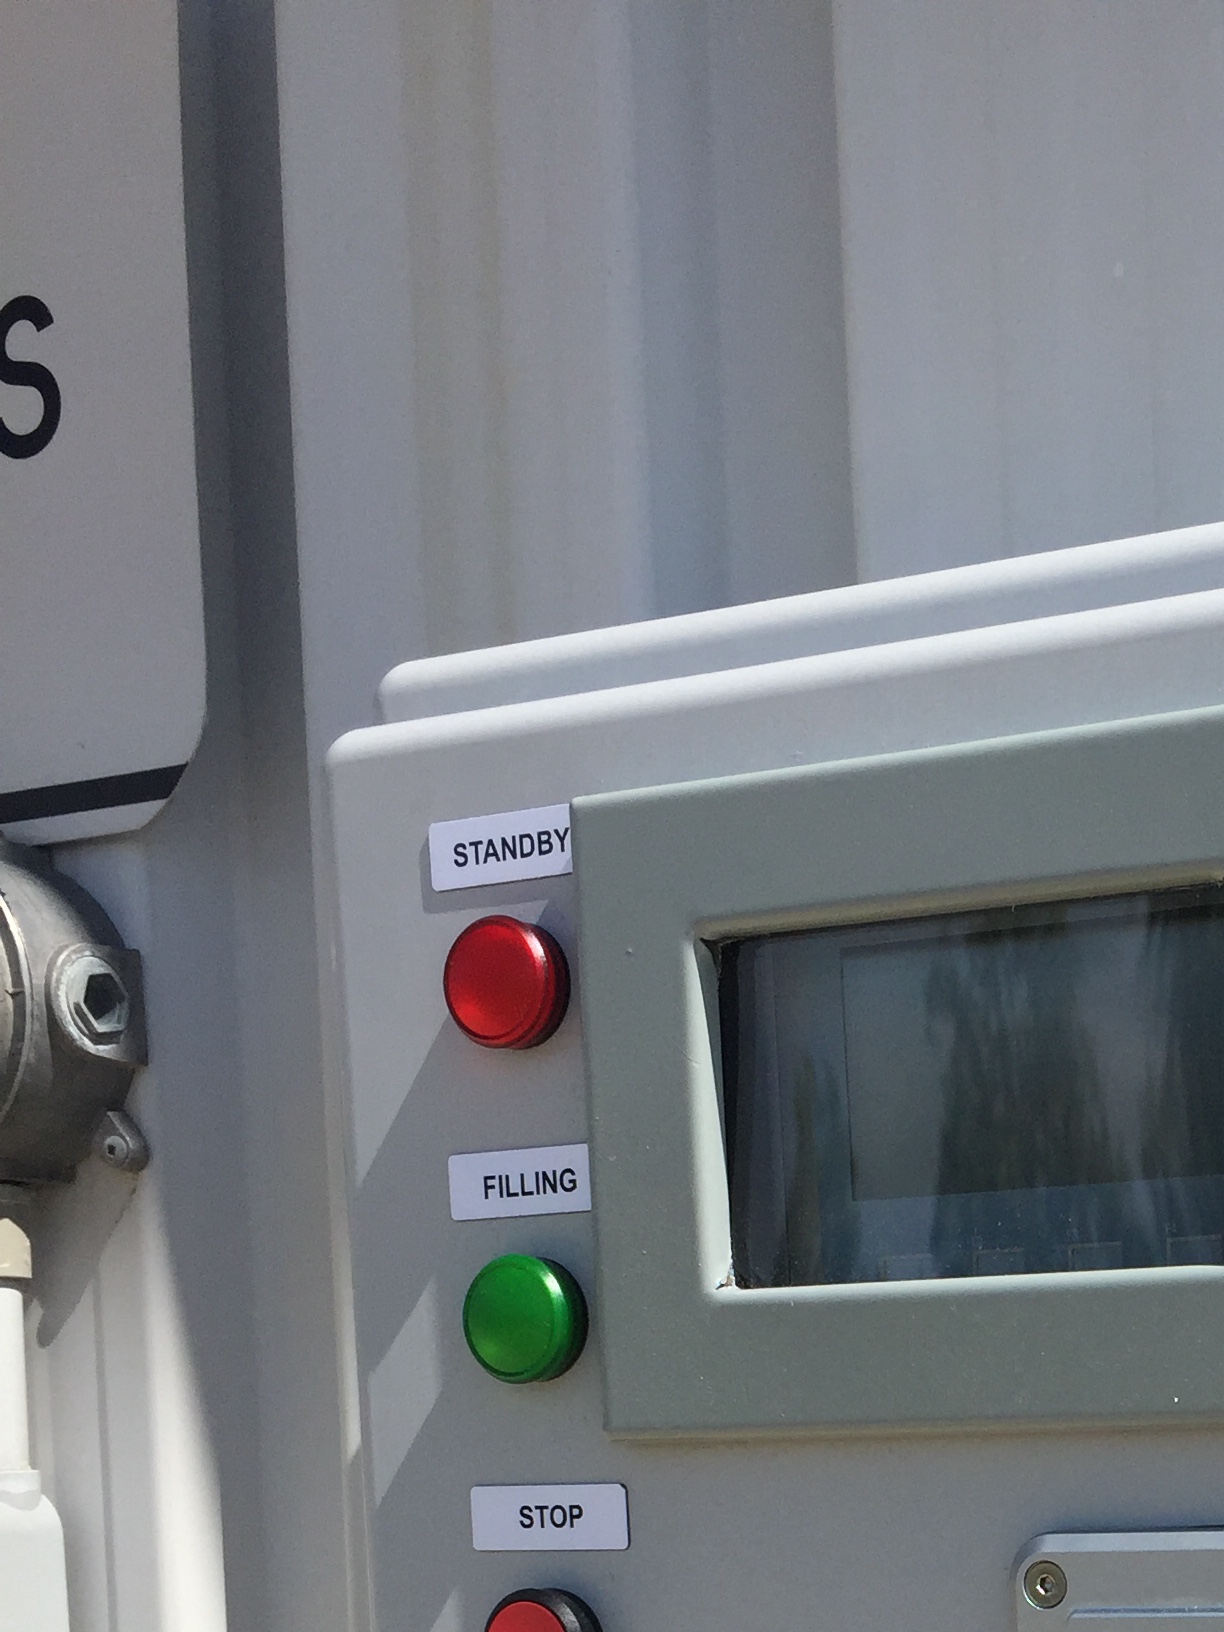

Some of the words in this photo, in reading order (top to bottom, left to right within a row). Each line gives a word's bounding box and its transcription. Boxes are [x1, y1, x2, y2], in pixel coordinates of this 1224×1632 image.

[452, 828, 571, 868] STANDBY
[482, 1168, 579, 1200] FILLING
[519, 1504, 584, 1530] STOP
